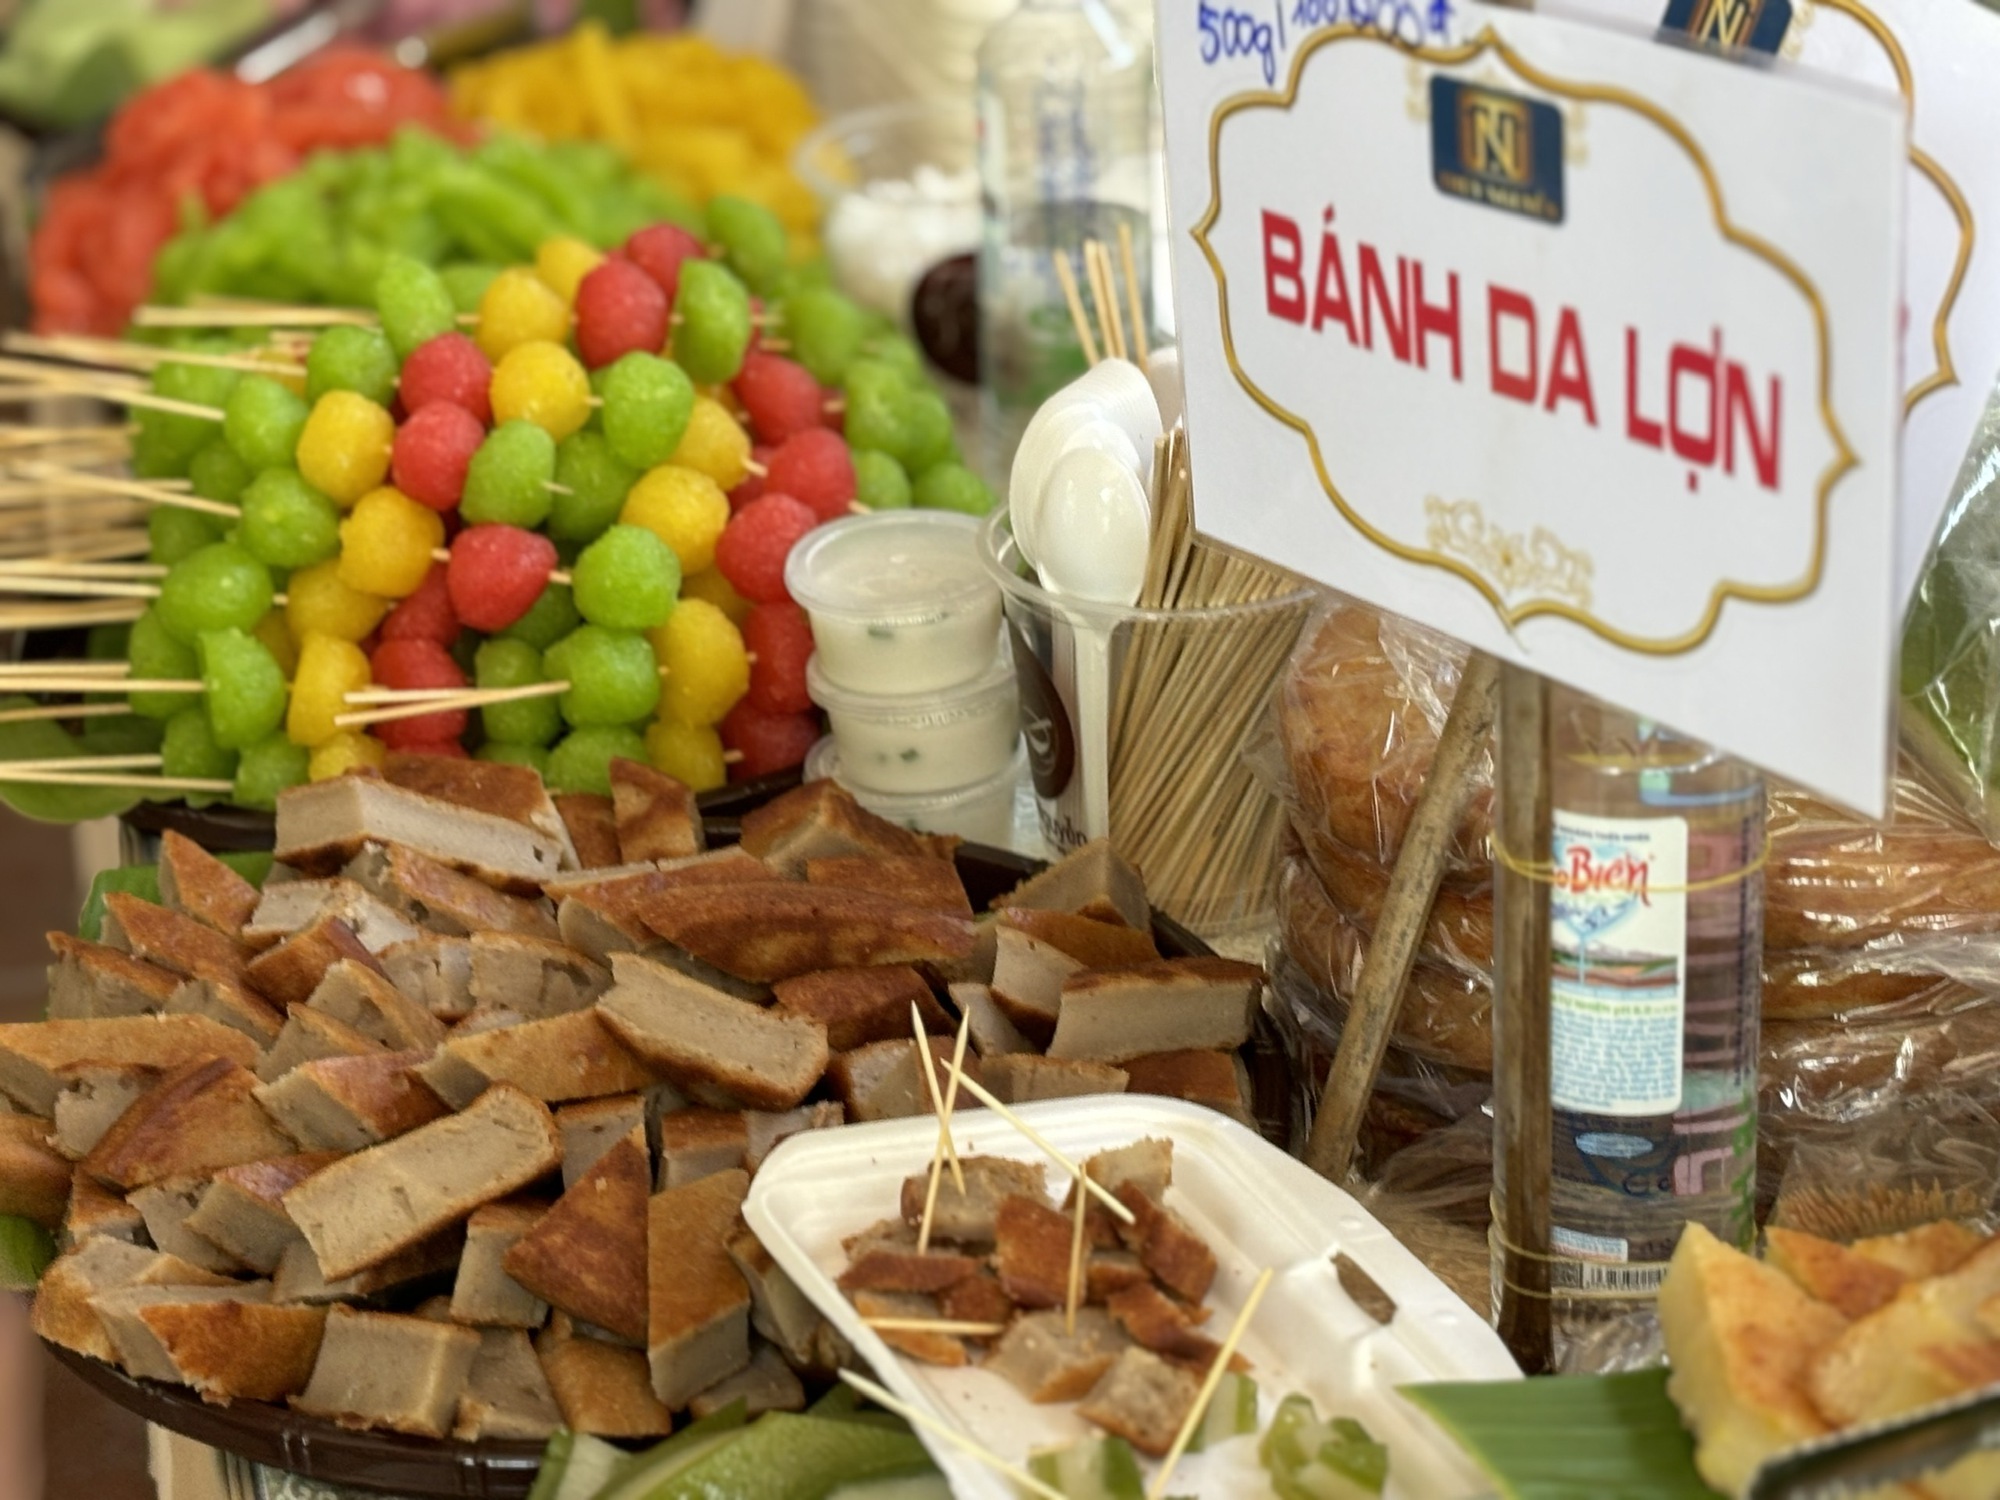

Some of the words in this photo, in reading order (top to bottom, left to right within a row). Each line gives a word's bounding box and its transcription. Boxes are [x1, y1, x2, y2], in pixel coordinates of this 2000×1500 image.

[1261, 203, 1463, 382] BÁNH
[1488, 283, 1598, 428] DA
[1626, 324, 1781, 492] LỢN
